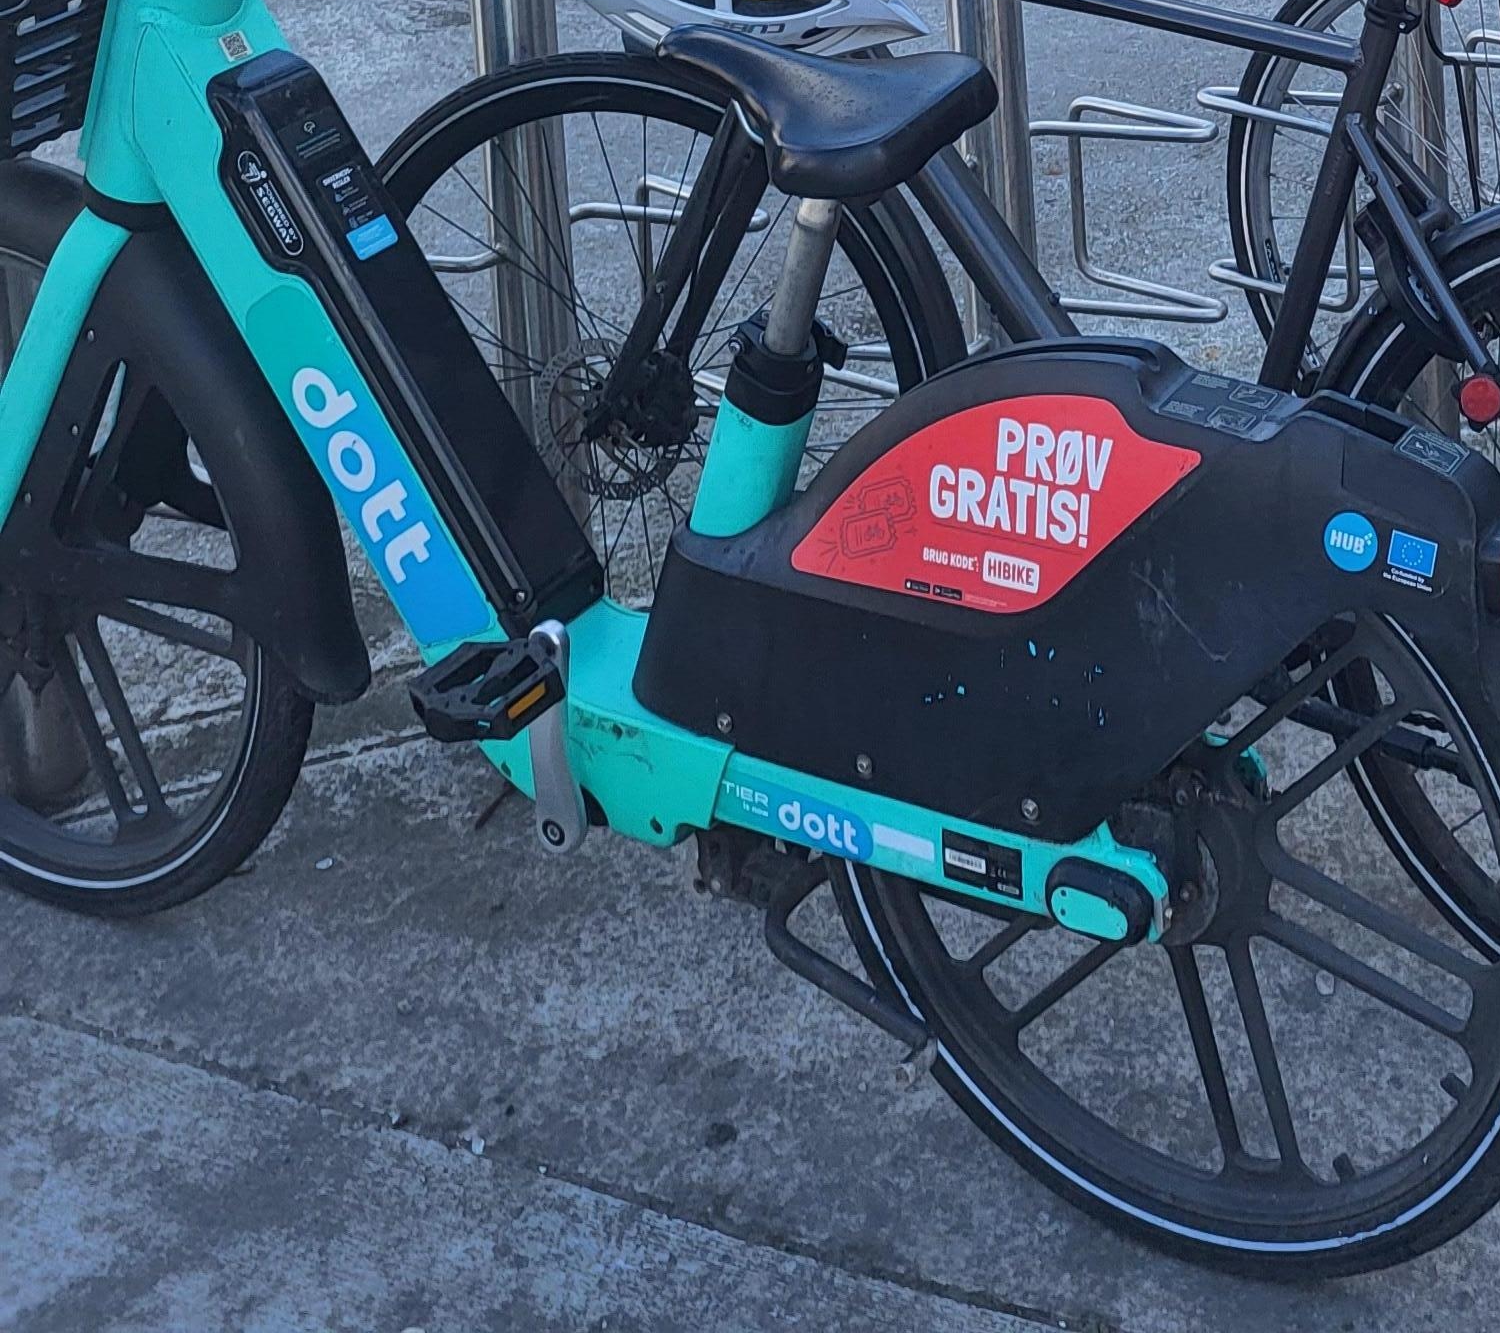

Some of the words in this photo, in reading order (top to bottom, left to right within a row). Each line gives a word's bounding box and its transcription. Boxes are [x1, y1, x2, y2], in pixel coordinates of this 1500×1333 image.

[256, 186, 294, 244] SEGWAY
[261, 182, 291, 228] POWERED
[287, 227, 298, 241] BY
[291, 367, 432, 585] dott
[996, 417, 1114, 491] PRØV
[929, 464, 1090, 549] GRATIS!
[922, 546, 949, 565] BRUG
[1329, 529, 1365, 555] HUB
[987, 558, 1035, 587] HIBIKE
[722, 780, 769, 808] TIER
[777, 800, 860, 856] dott
